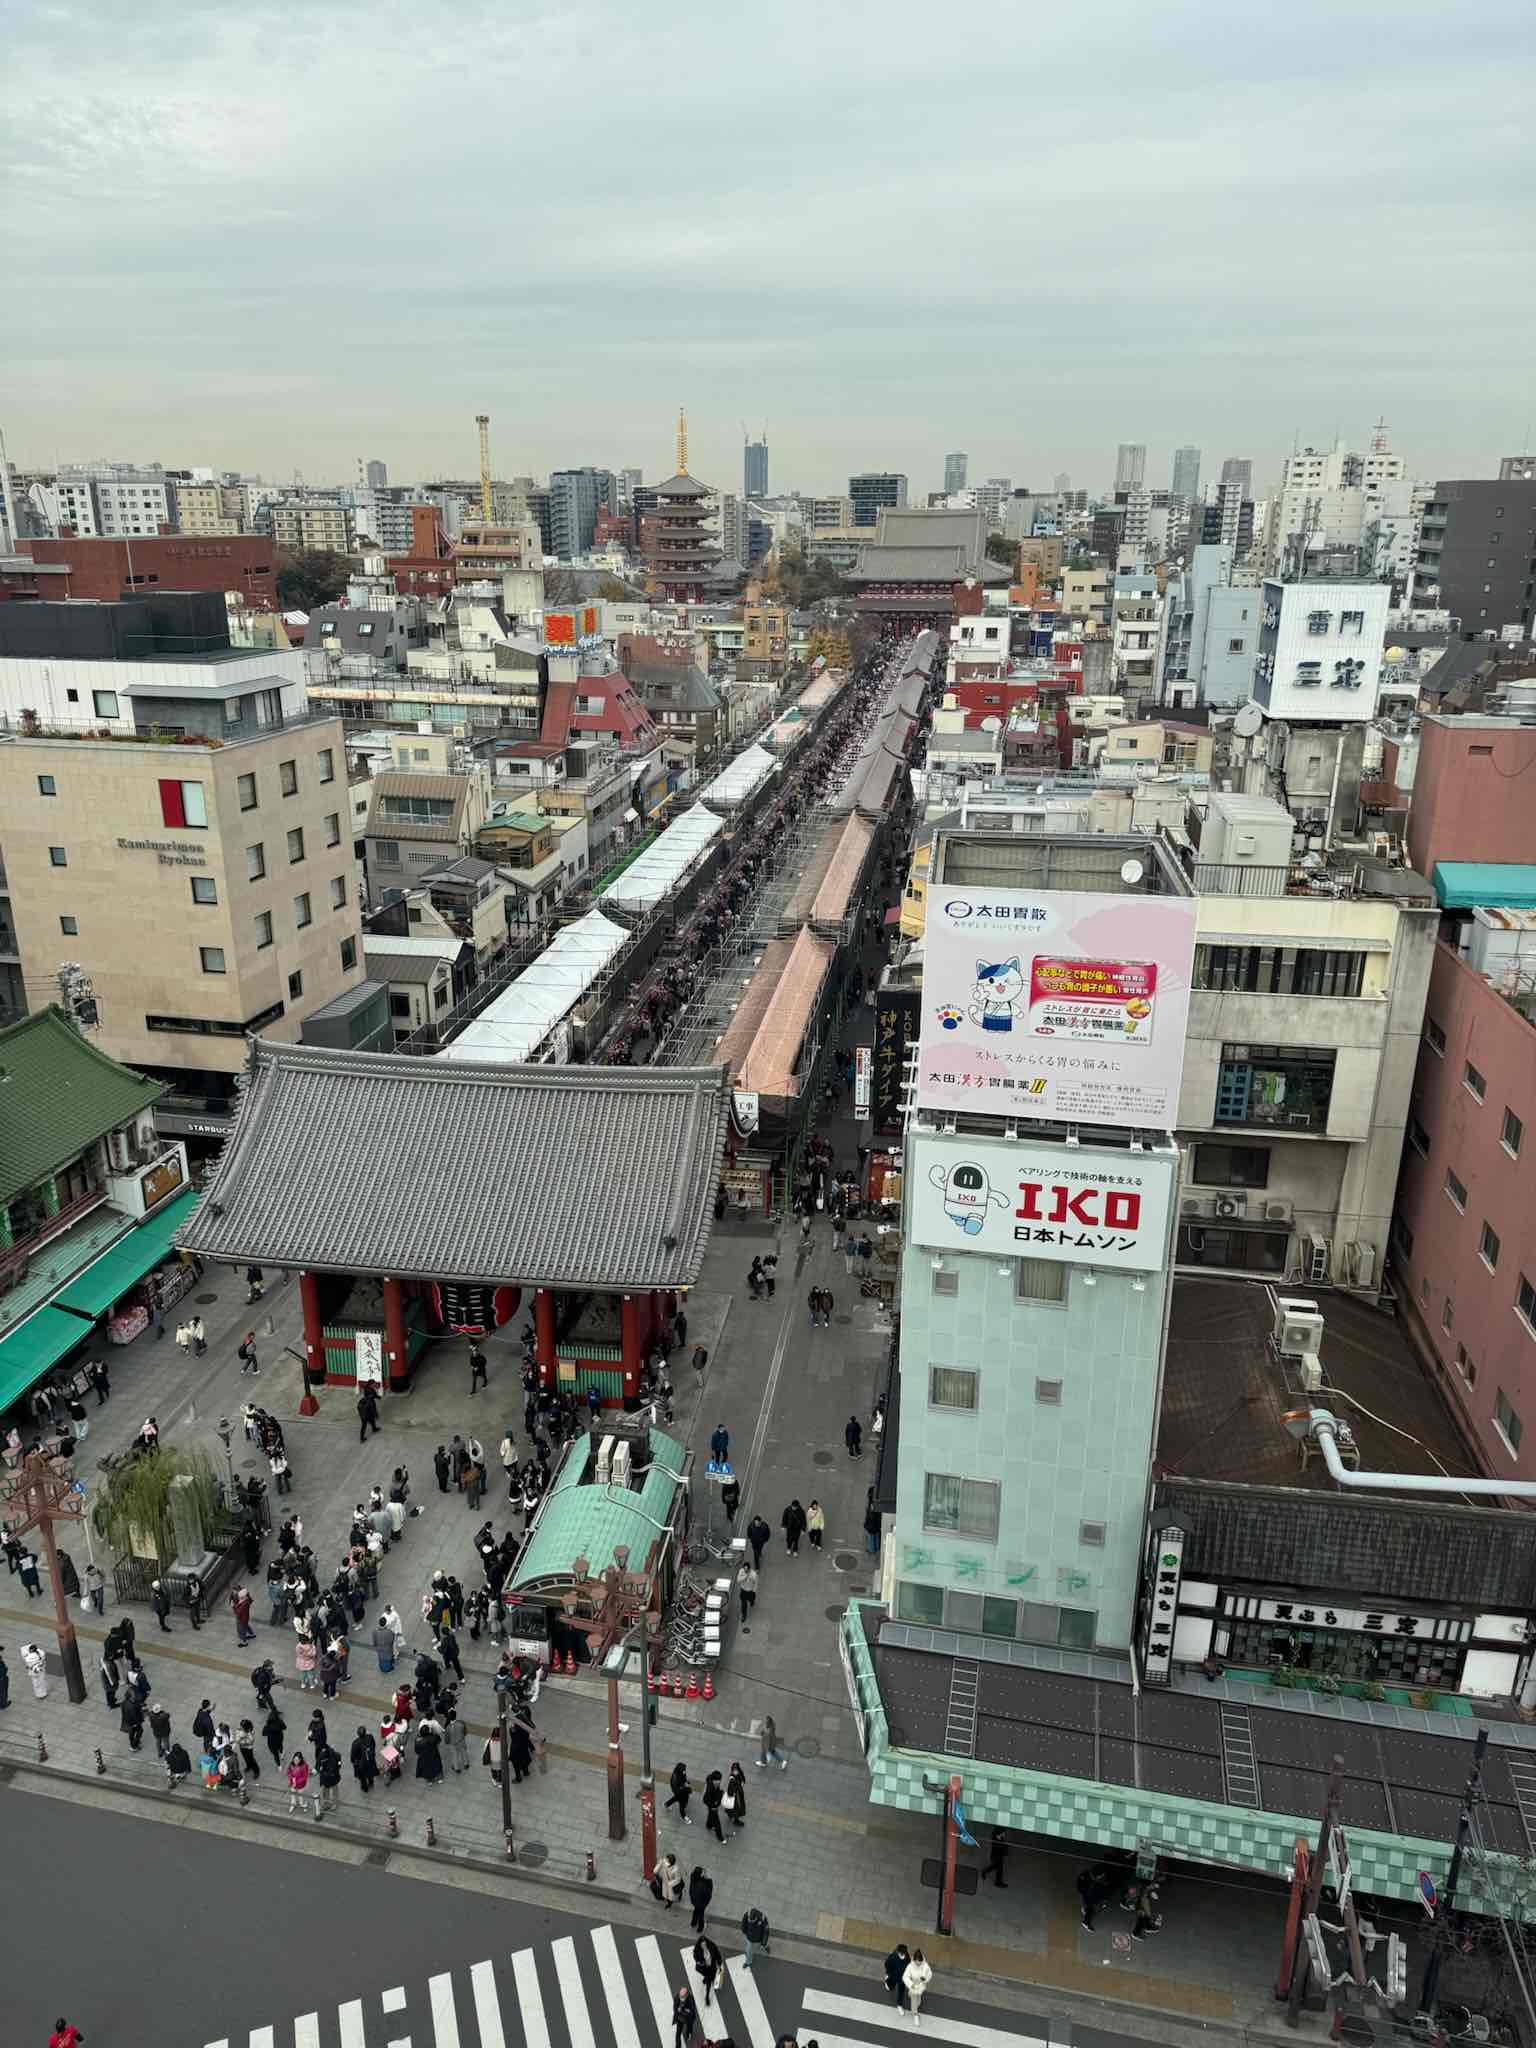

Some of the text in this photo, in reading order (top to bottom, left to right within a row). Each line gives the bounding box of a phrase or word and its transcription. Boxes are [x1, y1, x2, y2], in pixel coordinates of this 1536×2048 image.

[1308, 610, 1365, 635] 雷門
[1293, 657, 1366, 689] 三定
[116, 837, 205, 853] Kaminarimon
[158, 853, 206, 867] Ryokan
[975, 904, 1047, 921] 太田胃散
[975, 1050, 1121, 1072] ストレスからくる胃の悩みに
[957, 1193, 977, 1203] IKO
[1015, 1182, 1141, 1231] IKO
[1014, 1226, 1137, 1251] 日本トムソン
